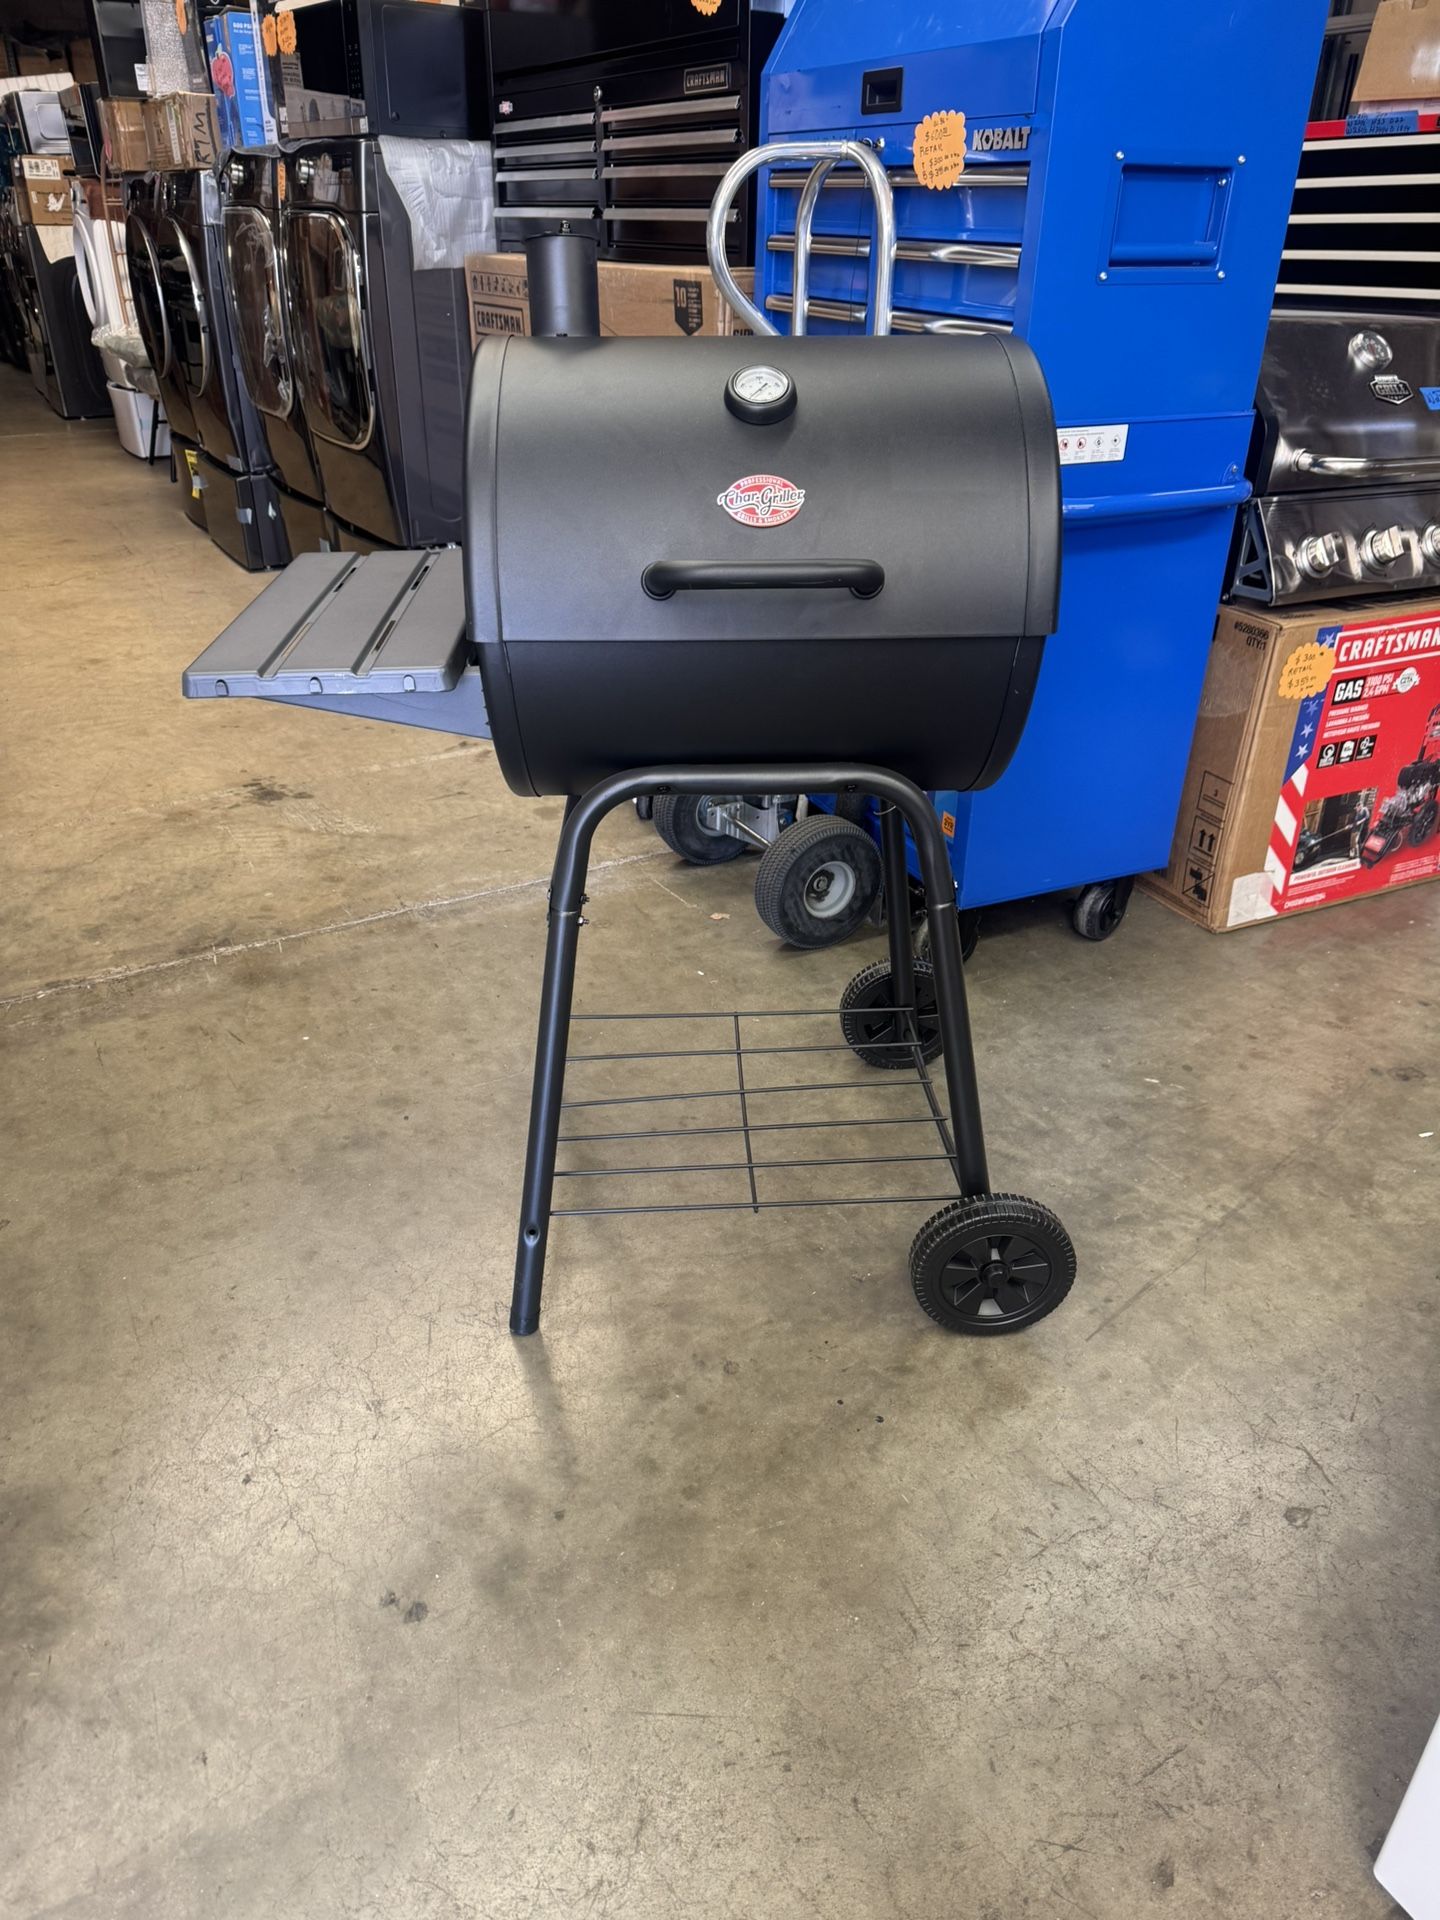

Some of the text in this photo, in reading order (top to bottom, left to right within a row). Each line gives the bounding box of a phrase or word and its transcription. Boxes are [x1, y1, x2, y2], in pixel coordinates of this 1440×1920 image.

[686, 70, 725, 87] CRAFTSMAN
[972, 126, 1031, 151] KOBALT
[675, 286, 687, 308] 10
[477, 310, 522, 334] CRAFTSMAN
[740, 476, 783, 486] PROFESSIONAL
[717, 487, 805, 516] Char-Griller
[737, 510, 757, 523] GRILLS
[764, 510, 792, 523] SMOKERS
[1334, 679, 1364, 702] GAS
